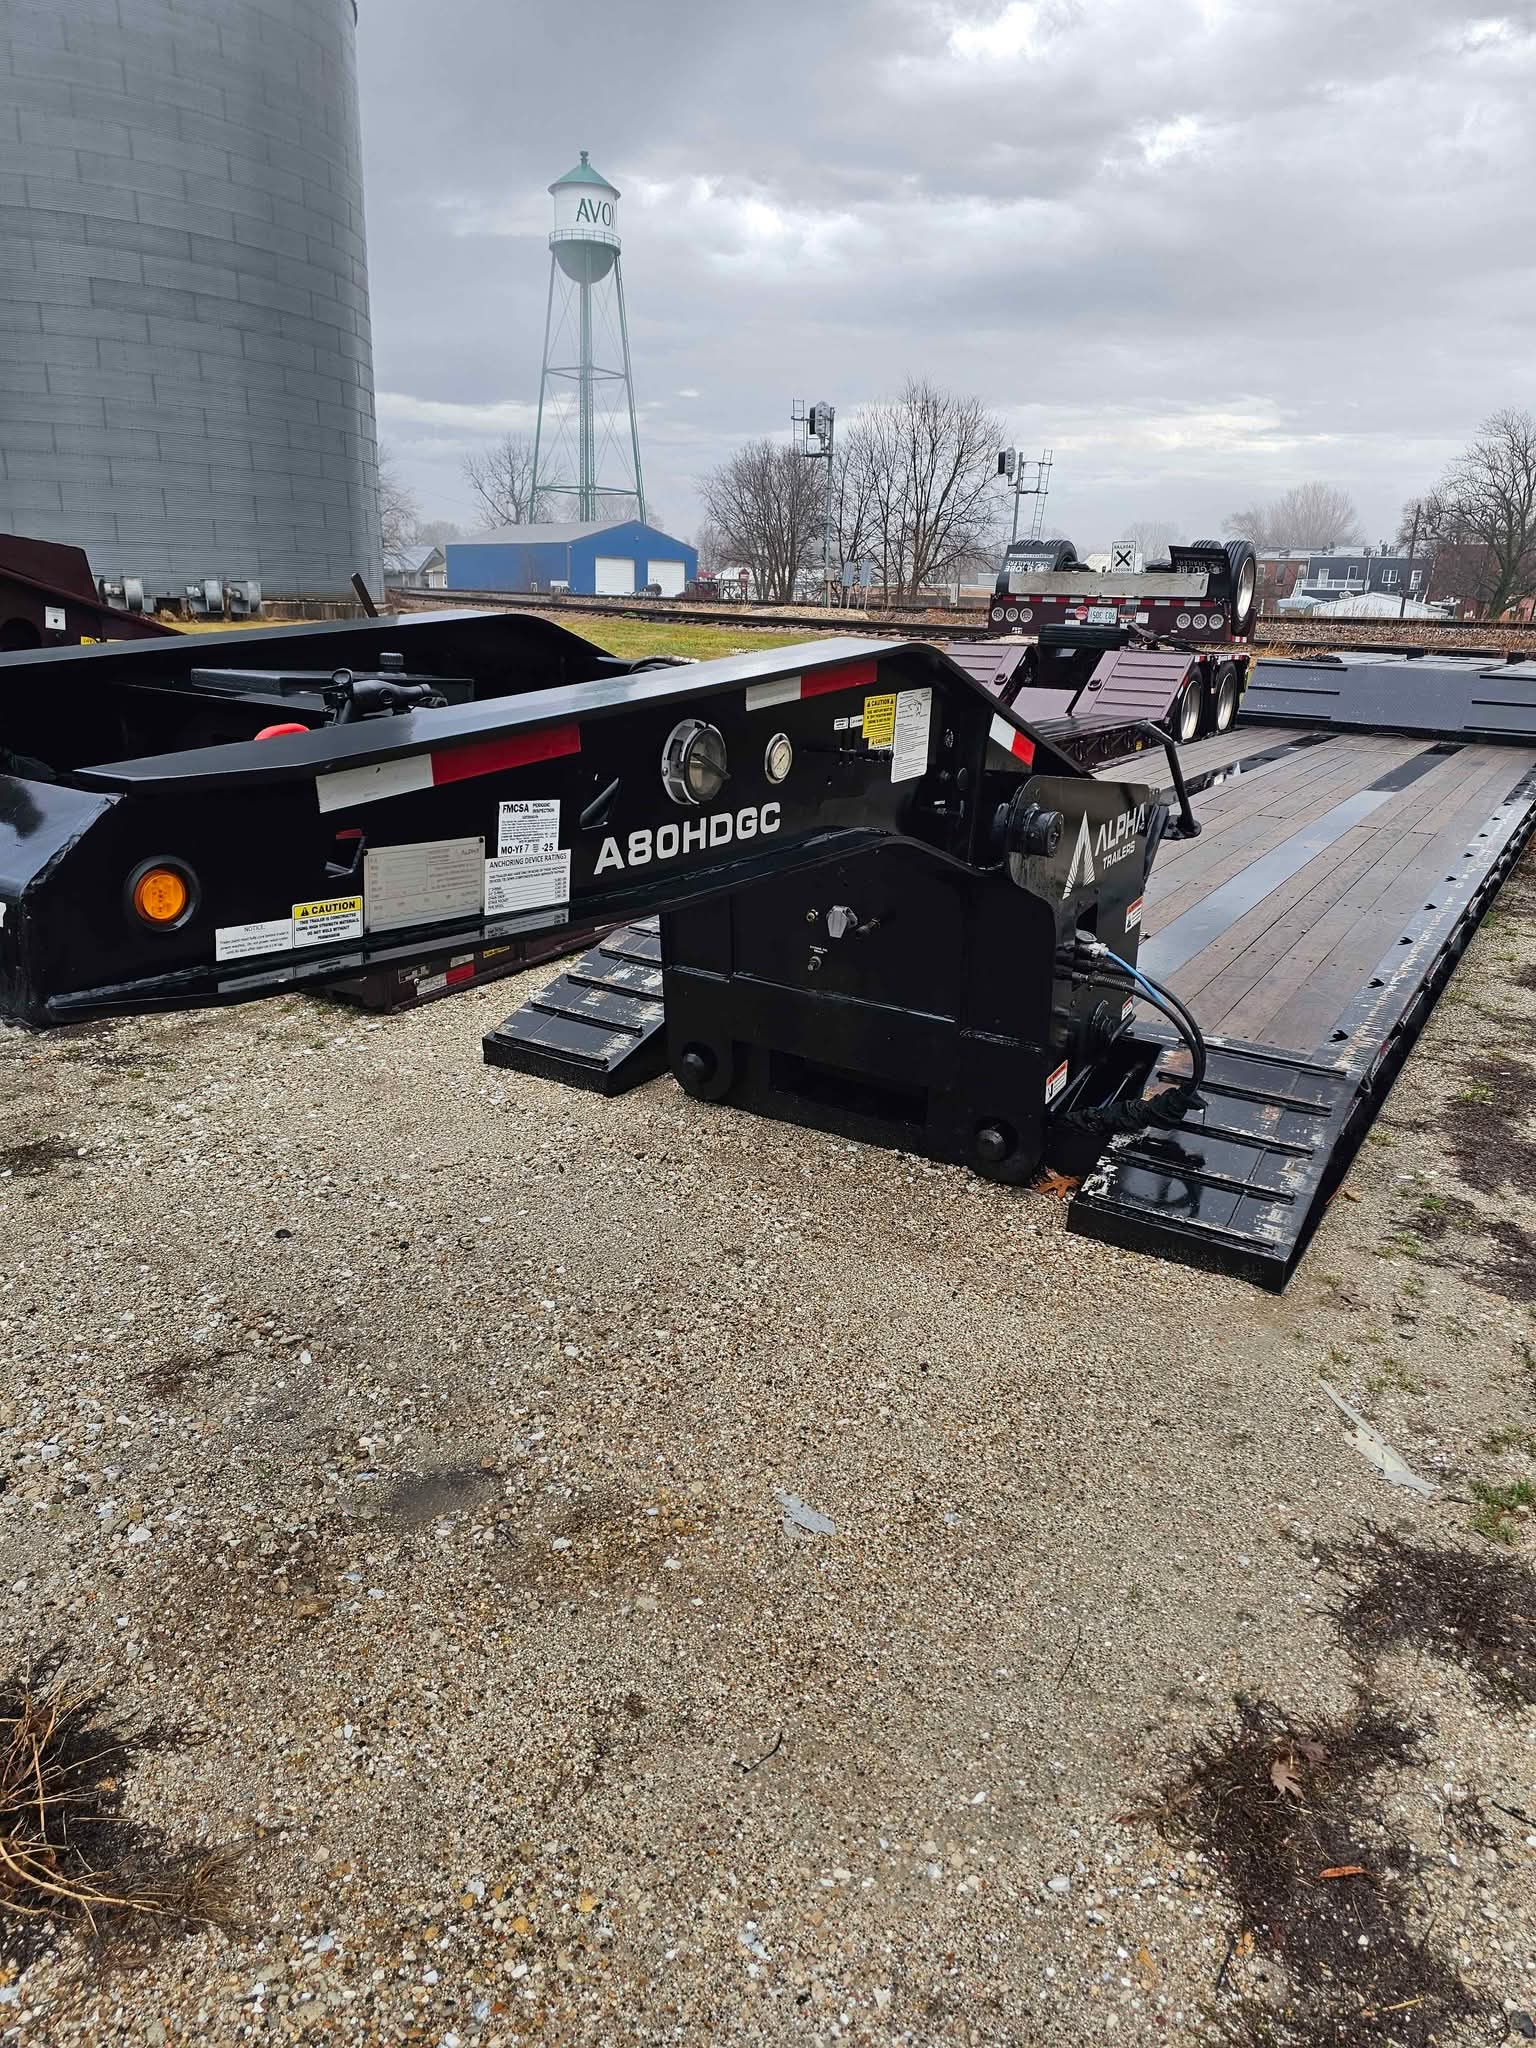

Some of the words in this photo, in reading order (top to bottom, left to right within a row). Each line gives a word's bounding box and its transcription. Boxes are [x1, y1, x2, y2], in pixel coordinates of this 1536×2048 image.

[503, 803, 529, 814] FMCSA
[1095, 803, 1145, 856] ALPHA
[593, 801, 781, 875] A80HDGC
[542, 843, 554, 852] -25
[1103, 840, 1136, 870] TRAILERS
[489, 857, 524, 868] ANCHORING
[525, 855, 544, 864] DEVICE
[544, 852, 567, 861] RATINGS
[311, 901, 356, 915] CAUTION
